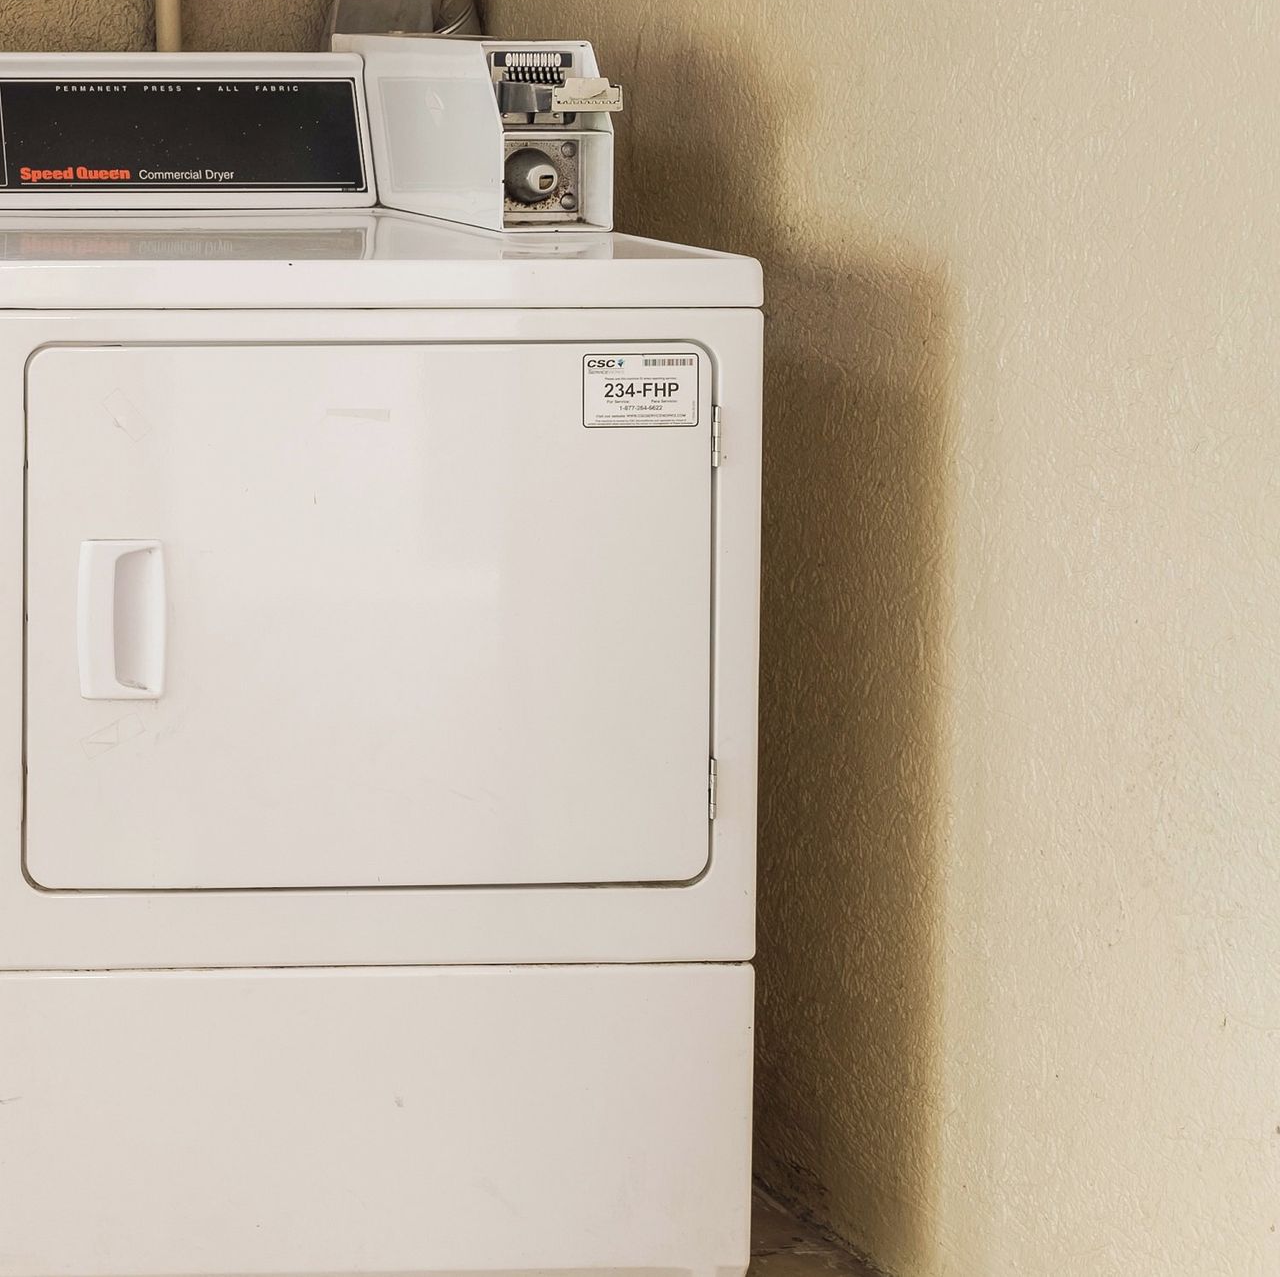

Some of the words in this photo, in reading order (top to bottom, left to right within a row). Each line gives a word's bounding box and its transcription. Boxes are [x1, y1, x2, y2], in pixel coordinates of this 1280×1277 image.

[20, 167, 74, 182] Speed
[77, 166, 130, 180] Queen
[139, 170, 202, 180] Commercial
[205, 170, 234, 182] Dryer
[587, 360, 615, 368] CSC
[605, 383, 679, 397] 234-FHP
